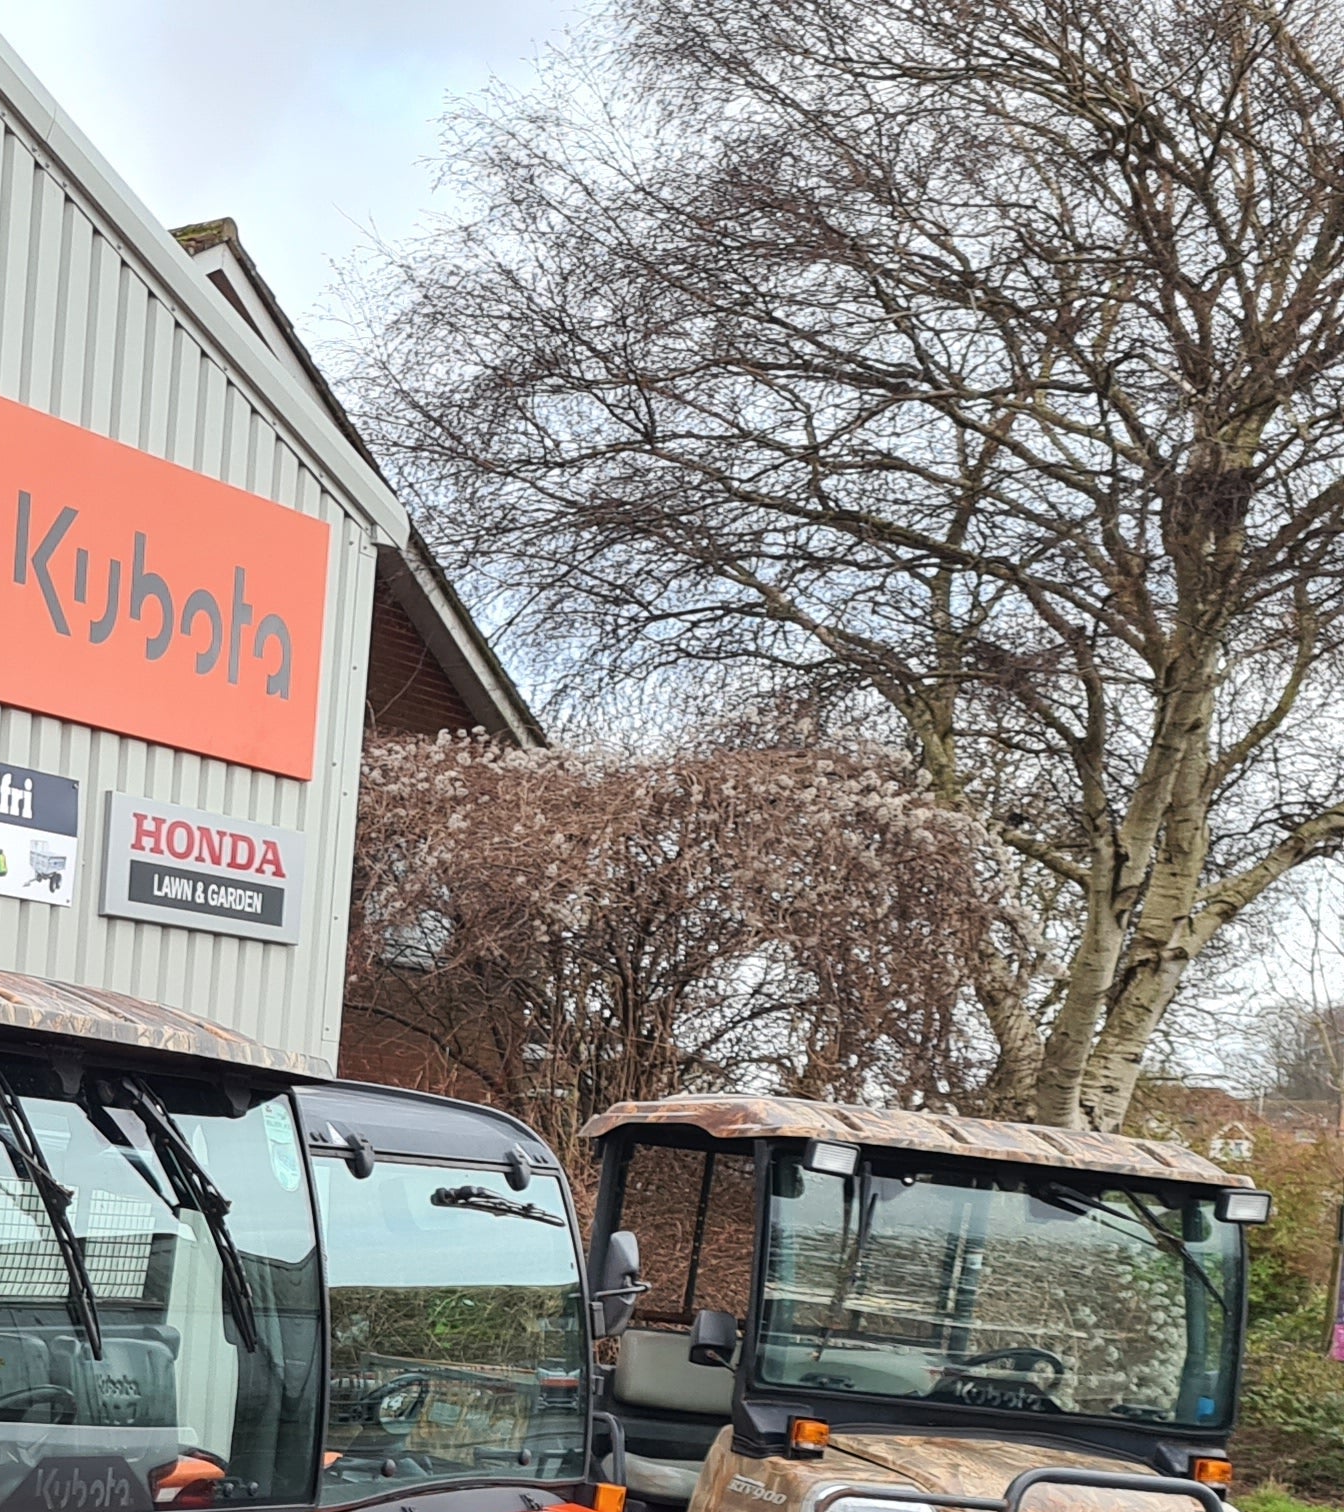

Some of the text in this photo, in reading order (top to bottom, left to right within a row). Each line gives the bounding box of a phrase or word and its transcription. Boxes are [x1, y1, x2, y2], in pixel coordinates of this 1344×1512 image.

[13, 489, 292, 701] Kubota
[130, 812, 286, 879] HONDA
[153, 873, 263, 914] LAWN & GARDEN
[35, 1466, 132, 1511] Kubota
